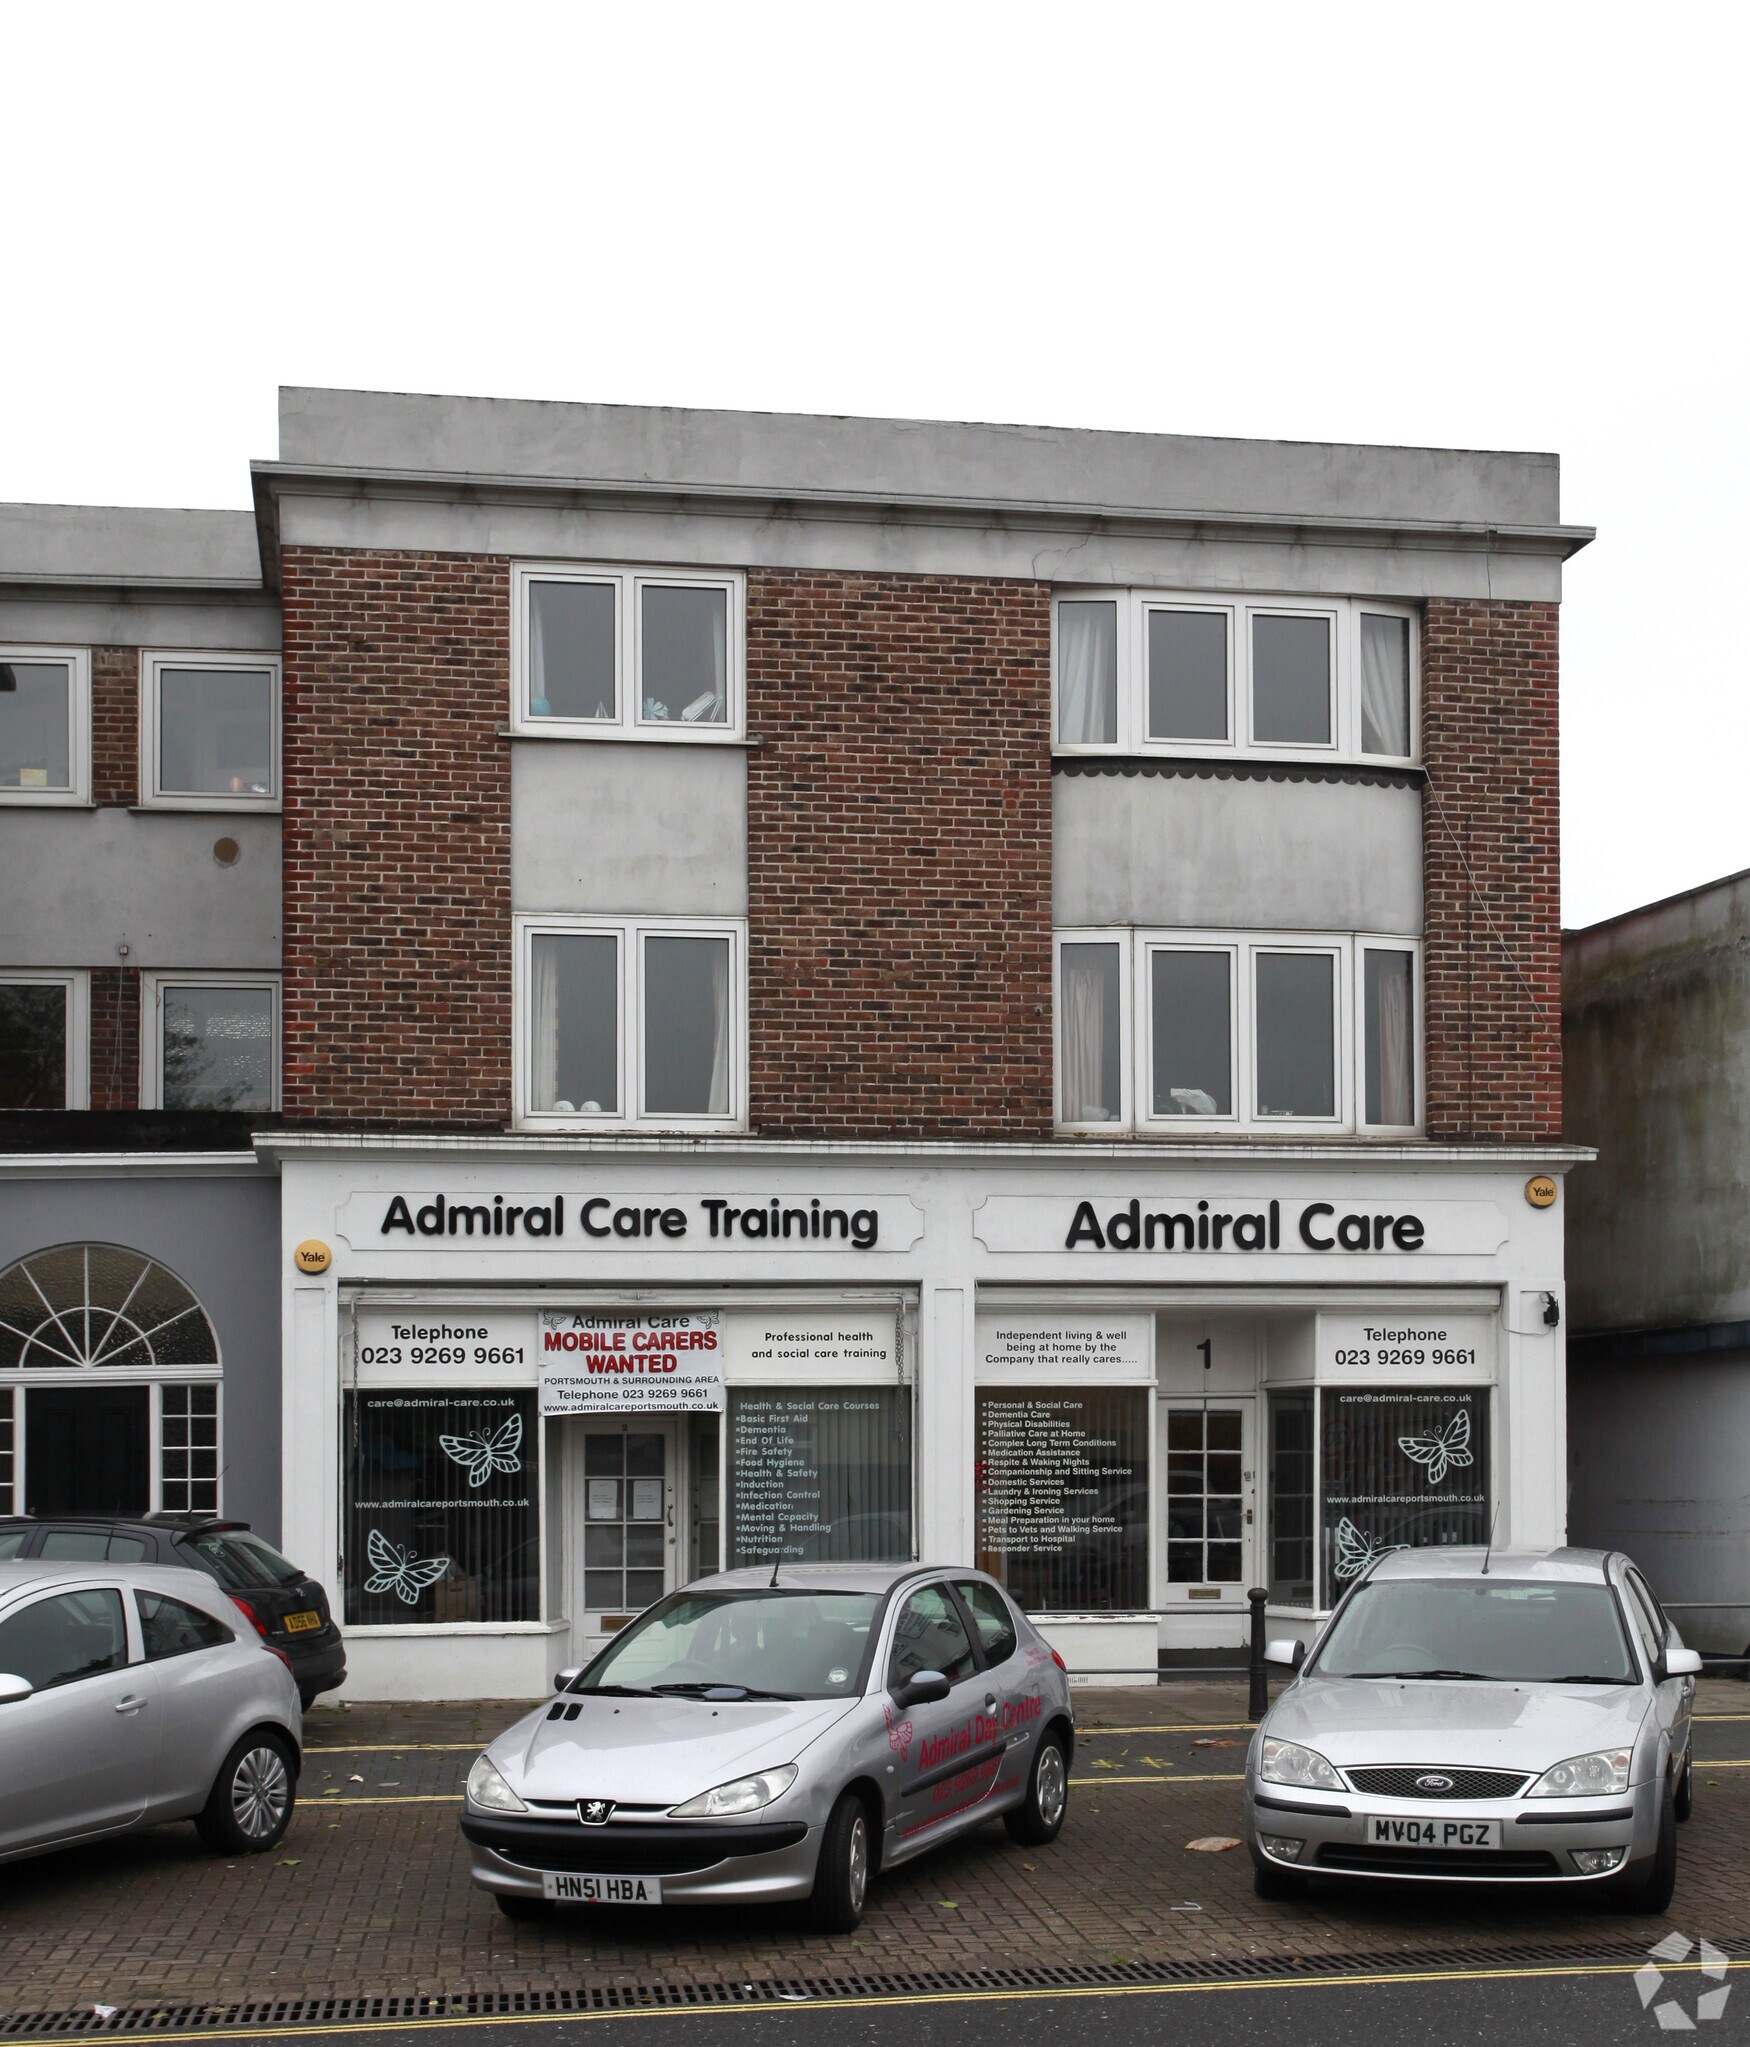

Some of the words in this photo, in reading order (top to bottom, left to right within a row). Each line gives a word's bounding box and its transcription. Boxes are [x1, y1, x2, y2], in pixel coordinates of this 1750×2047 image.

[1533, 1187, 1554, 1196] Yale
[380, 1194, 564, 1237] Admiral
[580, 1197, 688, 1238] Care
[701, 1198, 879, 1249] Training
[1065, 1198, 1279, 1251] Admiral
[1300, 1203, 1425, 1251] Care
[301, 1252, 325, 1262] Yale
[572, 1315, 641, 1329] Admiral
[648, 1316, 690, 1328] Care
[392, 1324, 488, 1343] Telephone
[765, 1332, 833, 1341] Professional
[838, 1332, 873, 1341] health
[996, 1331, 1062, 1341] Independent
[1066, 1331, 1092, 1341] living
[1096, 1332, 1103, 1340] &
[1106, 1331, 1127, 1340] well
[1364, 1328, 1447, 1343] Telephone
[544, 1332, 626, 1351] MOBILE
[632, 1331, 717, 1350] CARERS
[1007, 1343, 1035, 1353] being
[1052, 1343, 1082, 1351] home
[1085, 1343, 1096, 1352] by
[1100, 1343, 1117, 1351] the
[361, 1347, 402, 1364] 023
[411, 1347, 465, 1364] 9269
[474, 1347, 524, 1364] 9661
[752, 1349, 772, 1358] and
[778, 1349, 809, 1358] social
[844, 1349, 887, 1359] training
[1197, 1338, 1211, 1369] 1
[1335, 1350, 1370, 1365] 023
[1378, 1350, 1425, 1365] 9269
[1432, 1349, 1475, 1365] 9661
[586, 1354, 677, 1374] WANTED
[986, 1355, 1034, 1365] Company
[1038, 1355, 1058, 1363] that
[1062, 1355, 1090, 1365] really
[544, 1377, 610, 1385] PORTSMOUTH
[622, 1376, 692, 1384] SURROUNDING
[557, 1390, 619, 1400] Telephone
[623, 1390, 644, 1399] 023
[648, 1389, 677, 1398] 9269
[681, 1389, 708, 1398] 9661
[1340, 1394, 1472, 1402] care@admiral-care.co.uk
[367, 1398, 515, 1408] care@admiral-care.co.uk
[544, 1402, 718, 1412] www.admiralcareportsmouth.co.uk
[740, 1402, 771, 1410] Health
[988, 1421, 1022, 1429] Physical
[988, 1440, 1024, 1448] Complex
[1027, 1440, 1047, 1448] Long
[762, 1448, 793, 1457] Safety
[767, 1459, 805, 1468] Hygiene
[988, 1459, 1020, 1467] Respite
[1030, 1459, 1060, 1467] Waking
[1063, 1458, 1090, 1467] Nights
[787, 1469, 818, 1479] Safety
[988, 1468, 1052, 1476] Companionship
[1073, 1468, 1099, 1476] Sitting
[1033, 1488, 1061, 1496] Ironing
[355, 1499, 529, 1509] www.admiralcareportsmouth.co.uk
[988, 1498, 1027, 1506] Shopping
[1327, 1494, 1484, 1504] www.admiralcareportsmouth.co.uk
[988, 1507, 1031, 1515] Gardening
[741, 1513, 774, 1521] Mental
[778, 1513, 818, 1523] Capacity
[1011, 1517, 1059, 1525] Preparation
[741, 1524, 774, 1533] Moving
[779, 1524, 785, 1532] &
[790, 1524, 831, 1533] Handling
[1058, 1526, 1090, 1534] Walking
[741, 1535, 783, 1543] Nutrition
[988, 1536, 1028, 1544] Transport
[918, 1718, 970, 1772] Admiral
[975, 1714, 998, 1744] Day
[1002, 1695, 1041, 1731] Centre
[1425, 1777, 1445, 1788] Ford
[1376, 1820, 1435, 1842] MV04
[1443, 1823, 1490, 1845] PGZ
[606, 1879, 648, 1900] HBA
